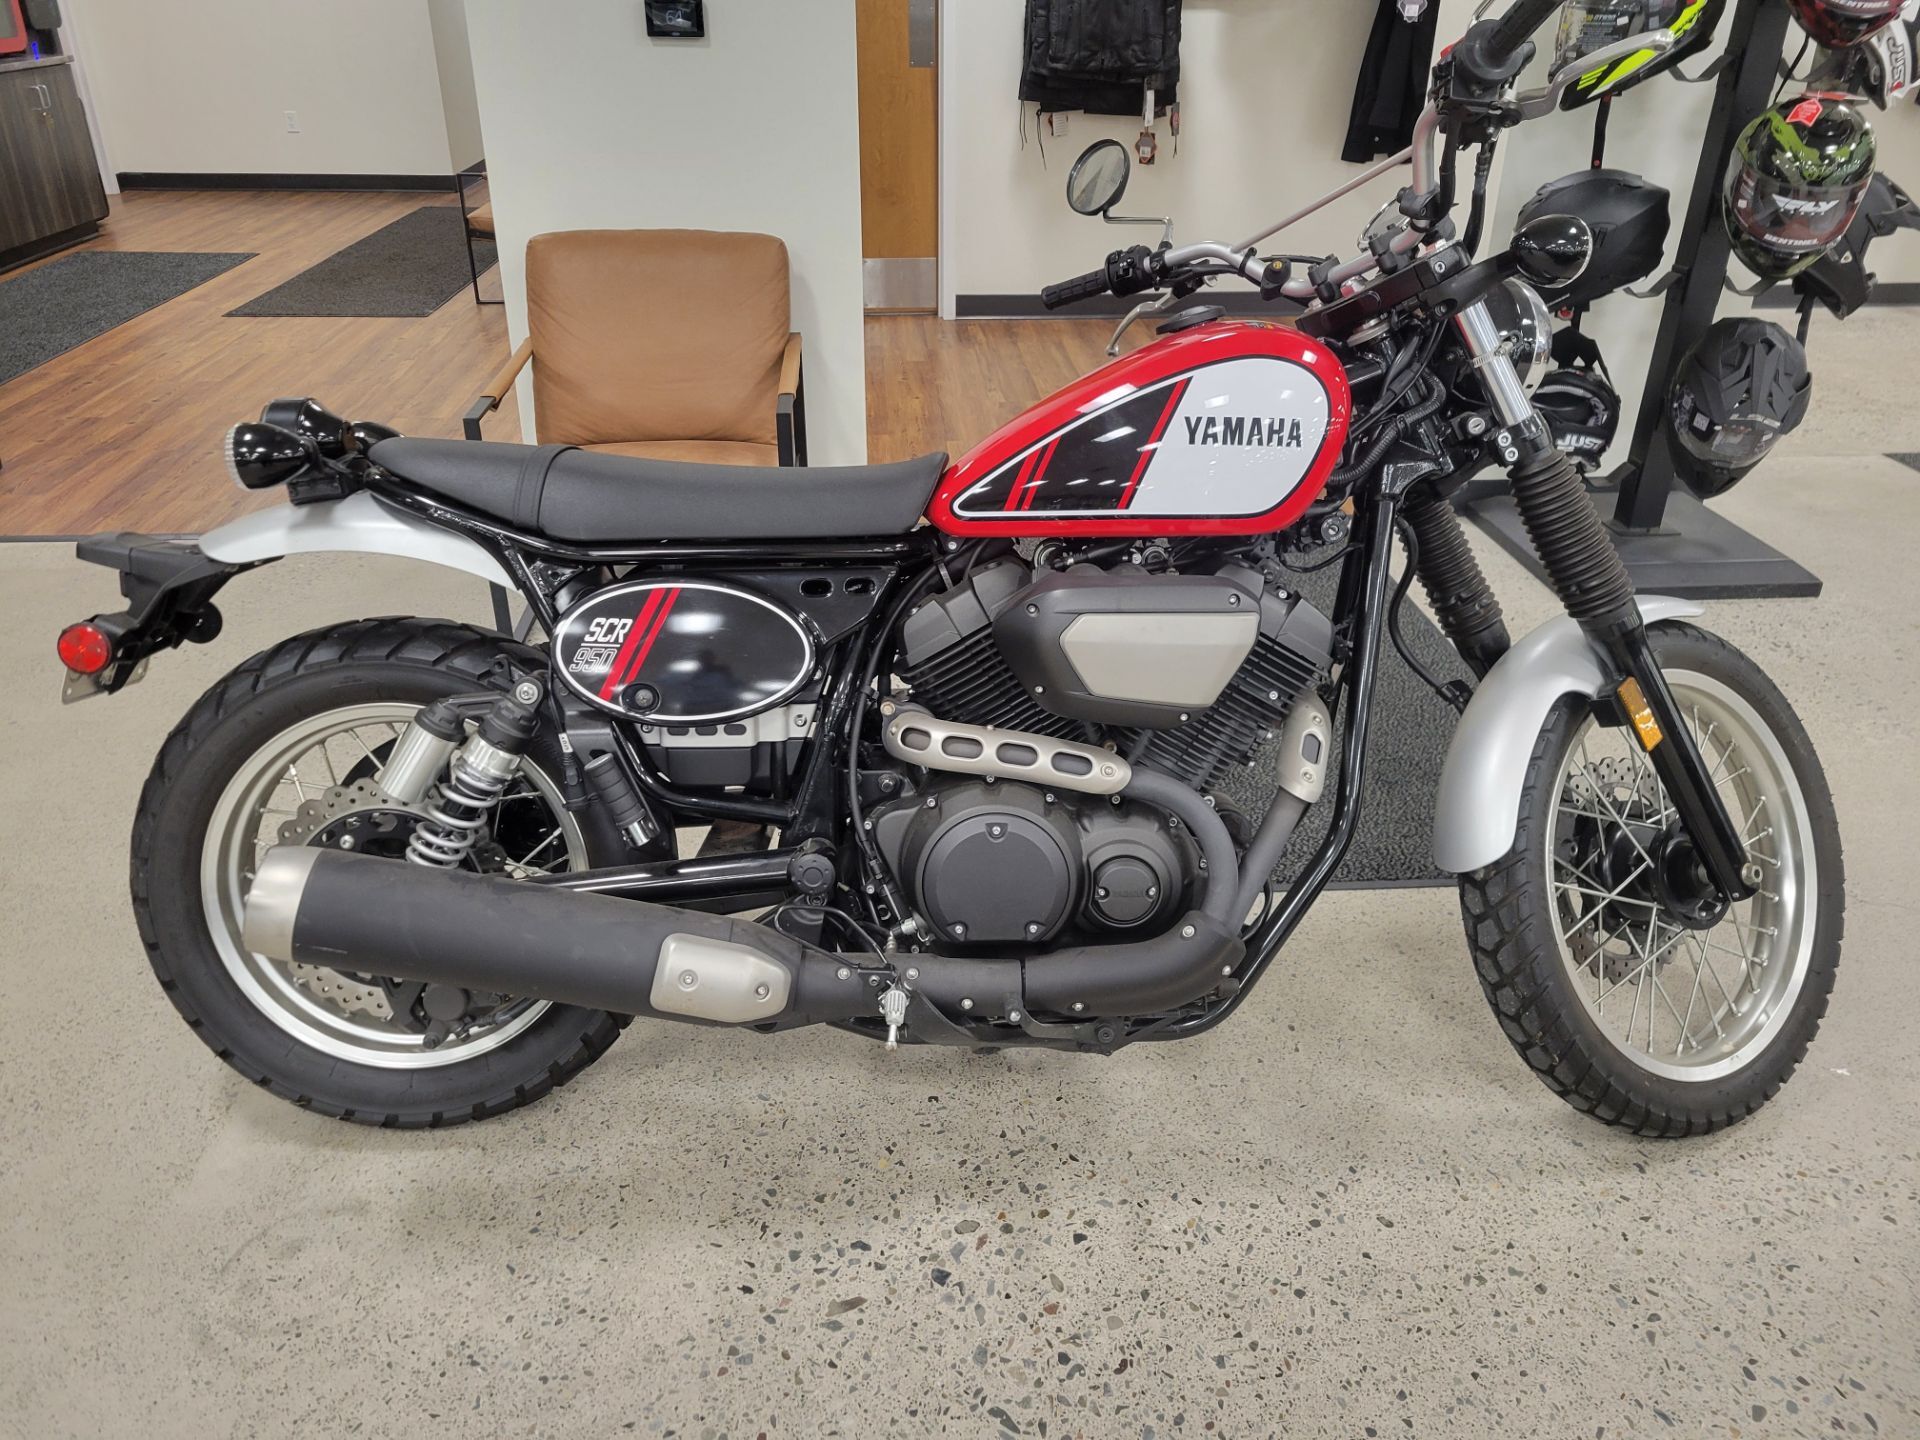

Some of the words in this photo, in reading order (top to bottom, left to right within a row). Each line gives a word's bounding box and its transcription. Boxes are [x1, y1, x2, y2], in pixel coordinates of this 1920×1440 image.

[1772, 193, 1840, 213] FLY
[1763, 233, 1819, 246] SENTINEL
[1184, 416, 1302, 448] YAMAHA
[584, 617, 634, 643] SCR
[569, 647, 618, 673] 950
